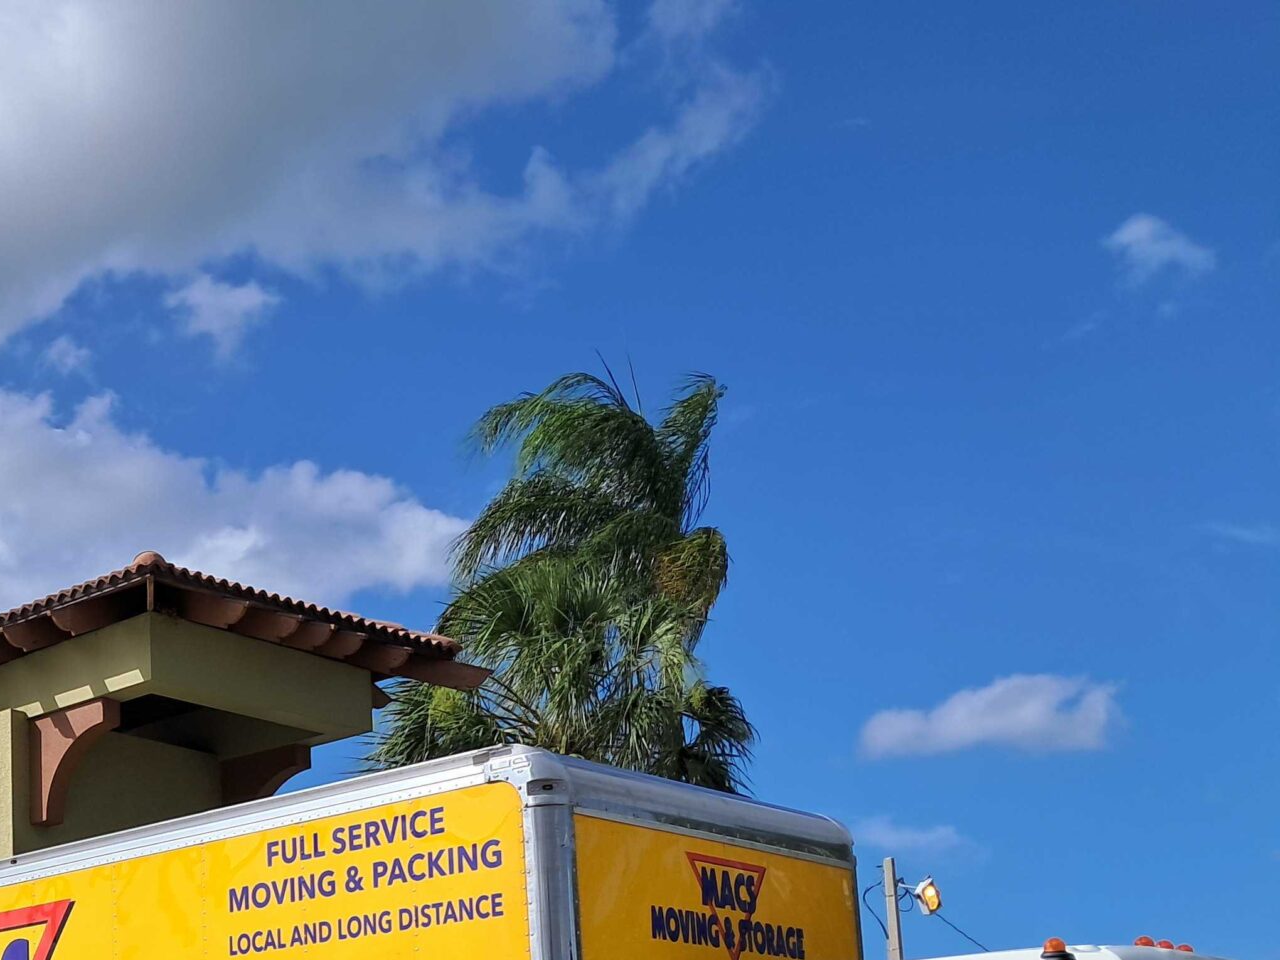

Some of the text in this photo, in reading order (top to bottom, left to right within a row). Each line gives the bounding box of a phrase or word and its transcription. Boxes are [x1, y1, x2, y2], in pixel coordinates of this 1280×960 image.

[267, 807, 445, 867] FULL SERVICE
[228, 839, 503, 912] MOVING & PACKING
[701, 866, 757, 914] MACS
[229, 893, 504, 956] LOCAL AND LONG DISTANCE
[651, 905, 806, 960] MOVING & STORAGE
